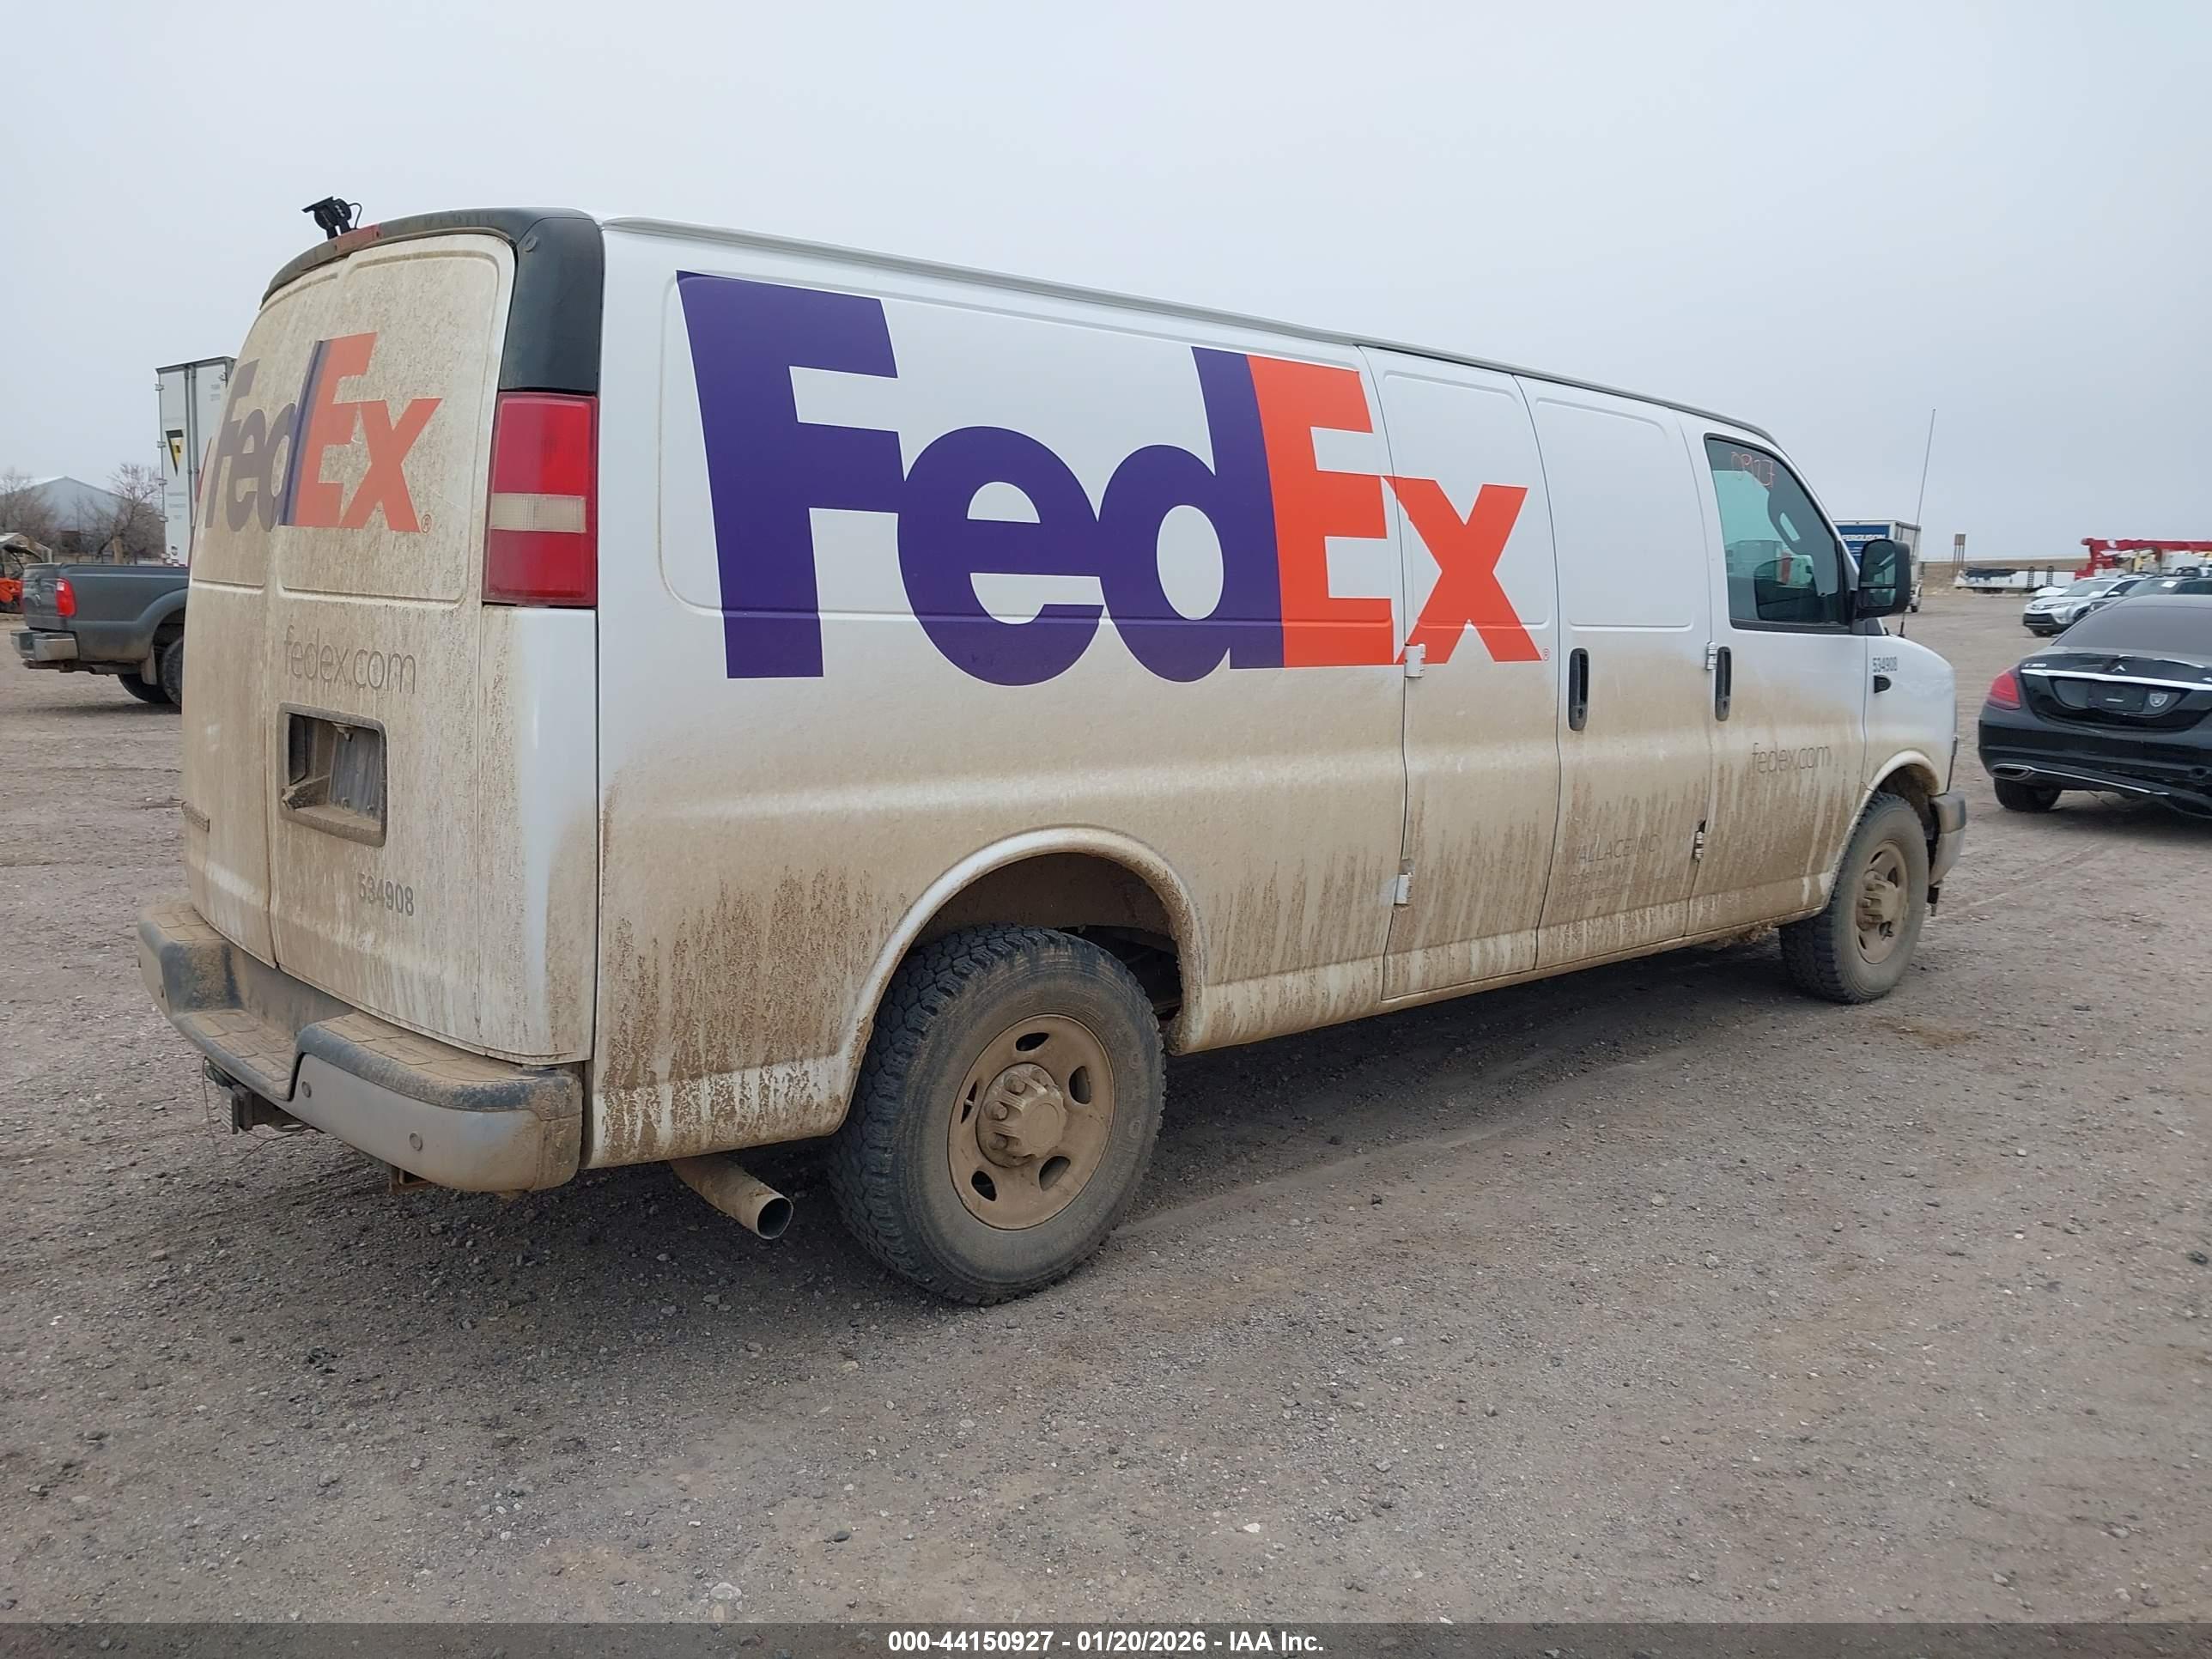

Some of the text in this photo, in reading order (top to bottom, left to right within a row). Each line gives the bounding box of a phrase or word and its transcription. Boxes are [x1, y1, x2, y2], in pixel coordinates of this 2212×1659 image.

[283, 624, 416, 695] fedex.com
[1751, 741, 1832, 774] fedex.com
[356, 871, 415, 917] 534908
